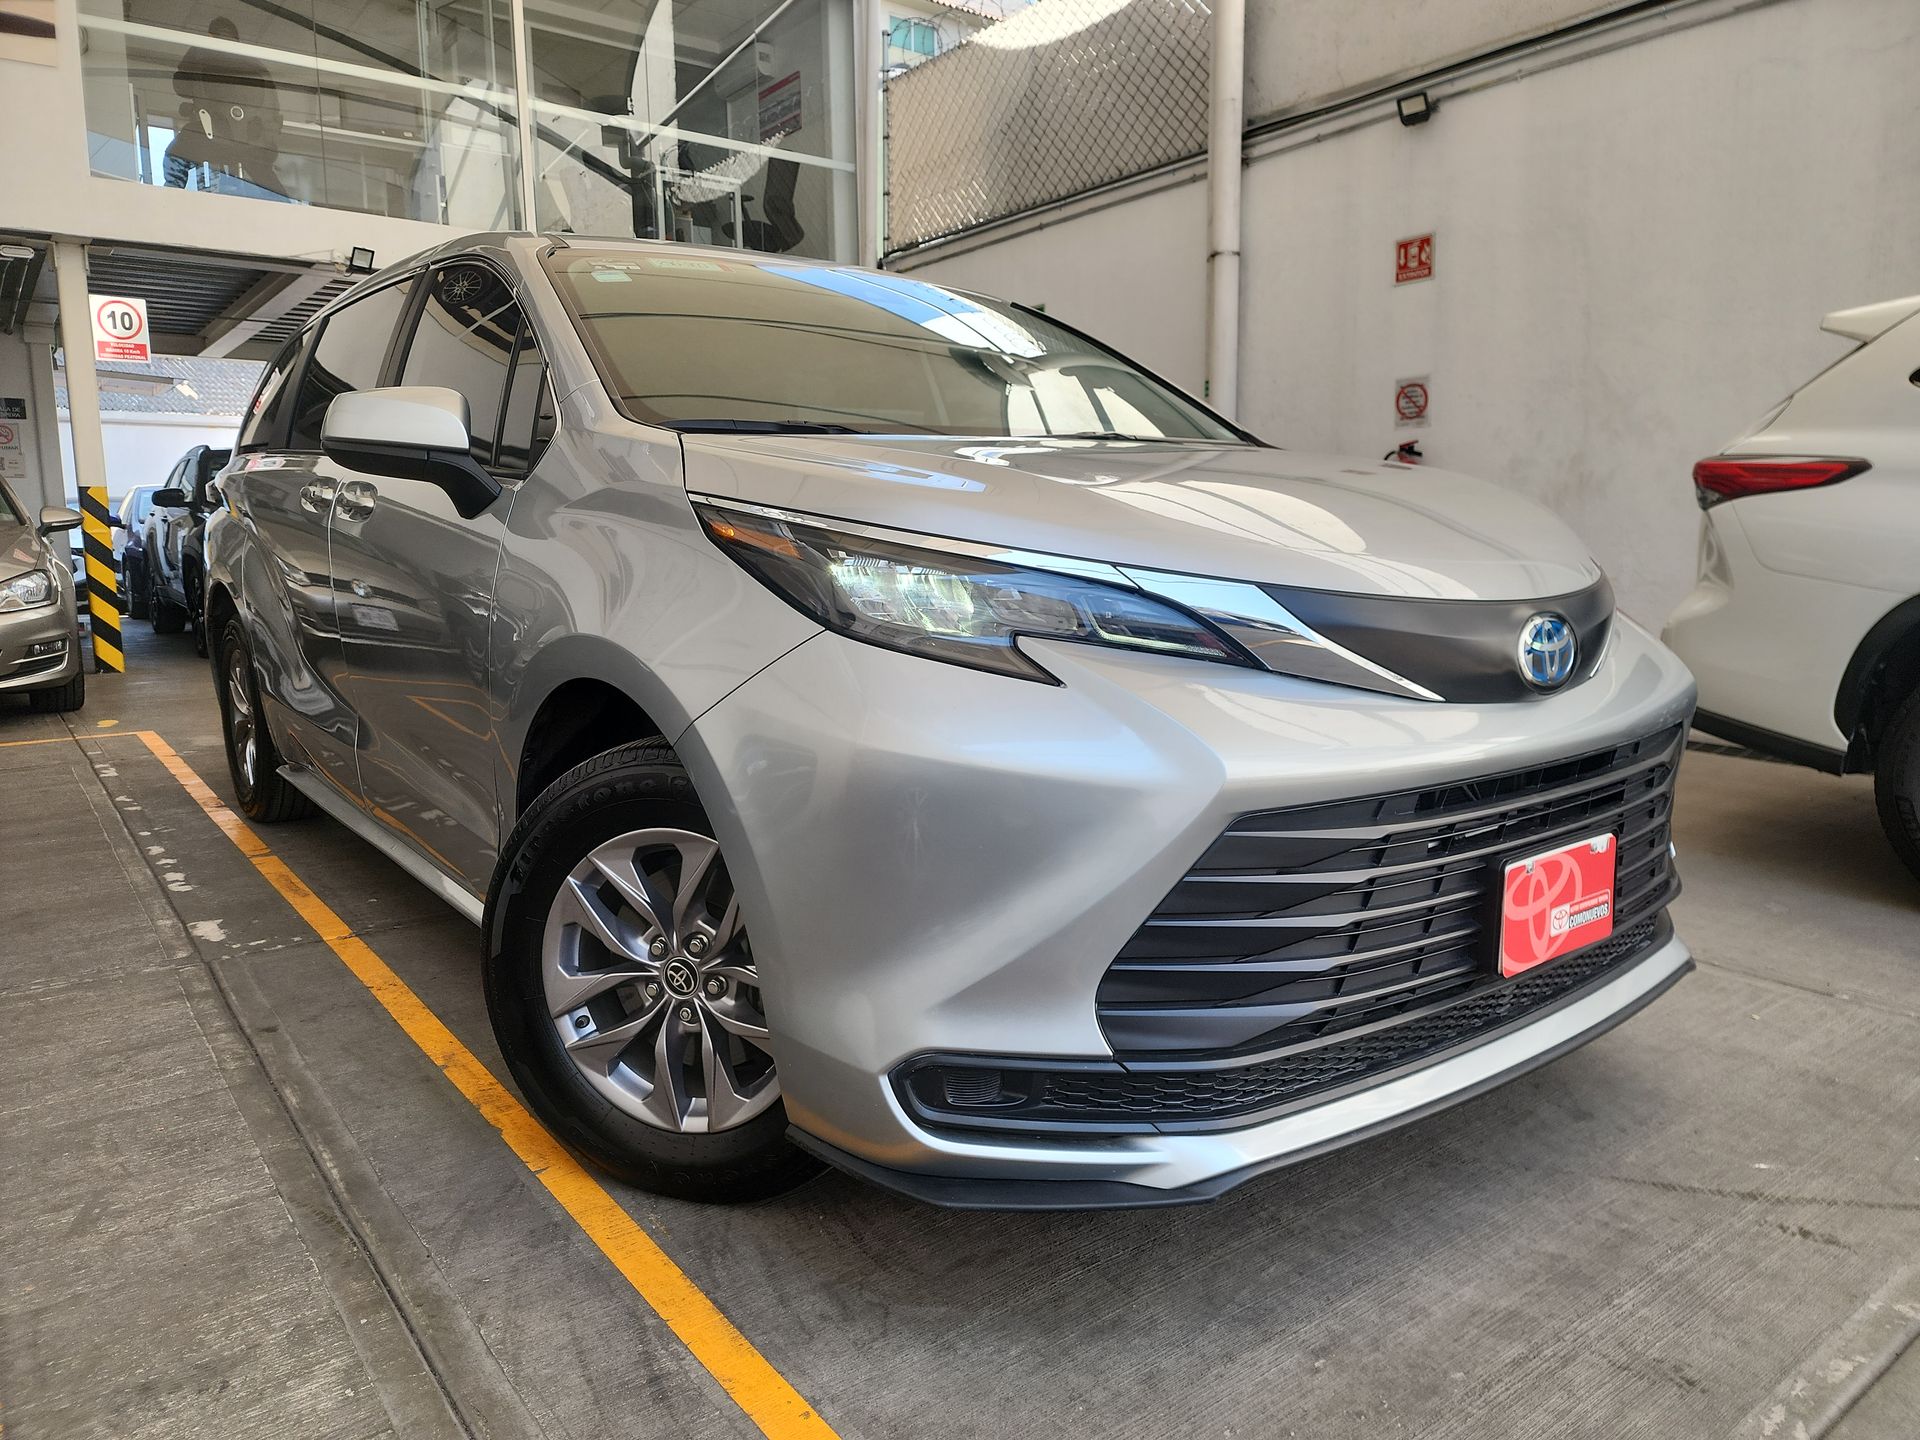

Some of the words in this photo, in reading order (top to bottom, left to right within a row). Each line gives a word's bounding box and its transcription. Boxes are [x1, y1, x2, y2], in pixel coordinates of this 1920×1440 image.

[1398, 268, 1430, 281] EXTINTOR
[106, 310, 133, 330] 10
[1569, 902, 1609, 928] COMONUEVOS
